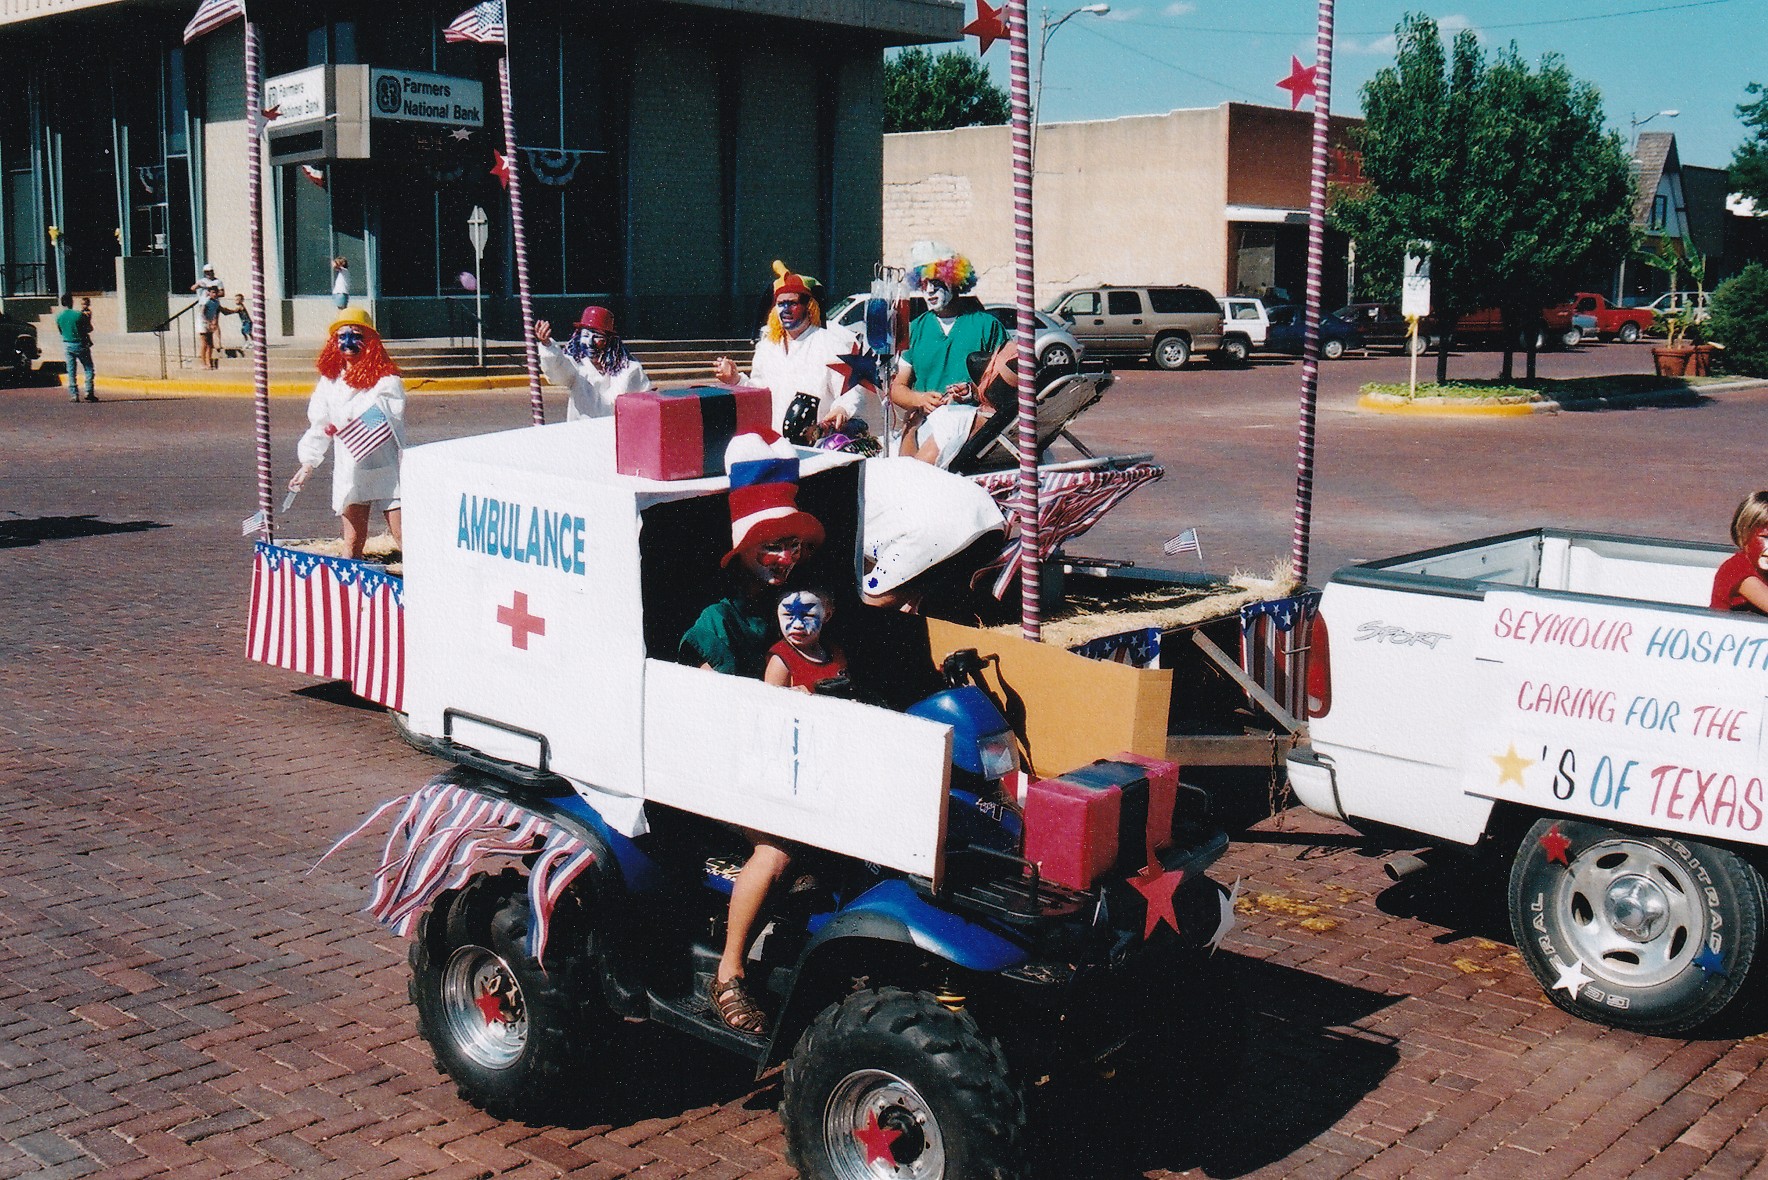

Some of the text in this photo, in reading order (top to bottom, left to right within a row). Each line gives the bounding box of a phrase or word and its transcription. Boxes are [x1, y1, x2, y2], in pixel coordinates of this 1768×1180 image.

[403, 77, 451, 97] Farmers
[403, 100, 481, 122] National Bank
[457, 492, 586, 576] AMBULANCE
[1353, 619, 1453, 650] SPORT
[1494, 608, 1633, 653] SEYMOUR
[1517, 681, 1748, 742] CARING FOR THE
[1542, 745, 1763, 832] 'S OF TEXAS
